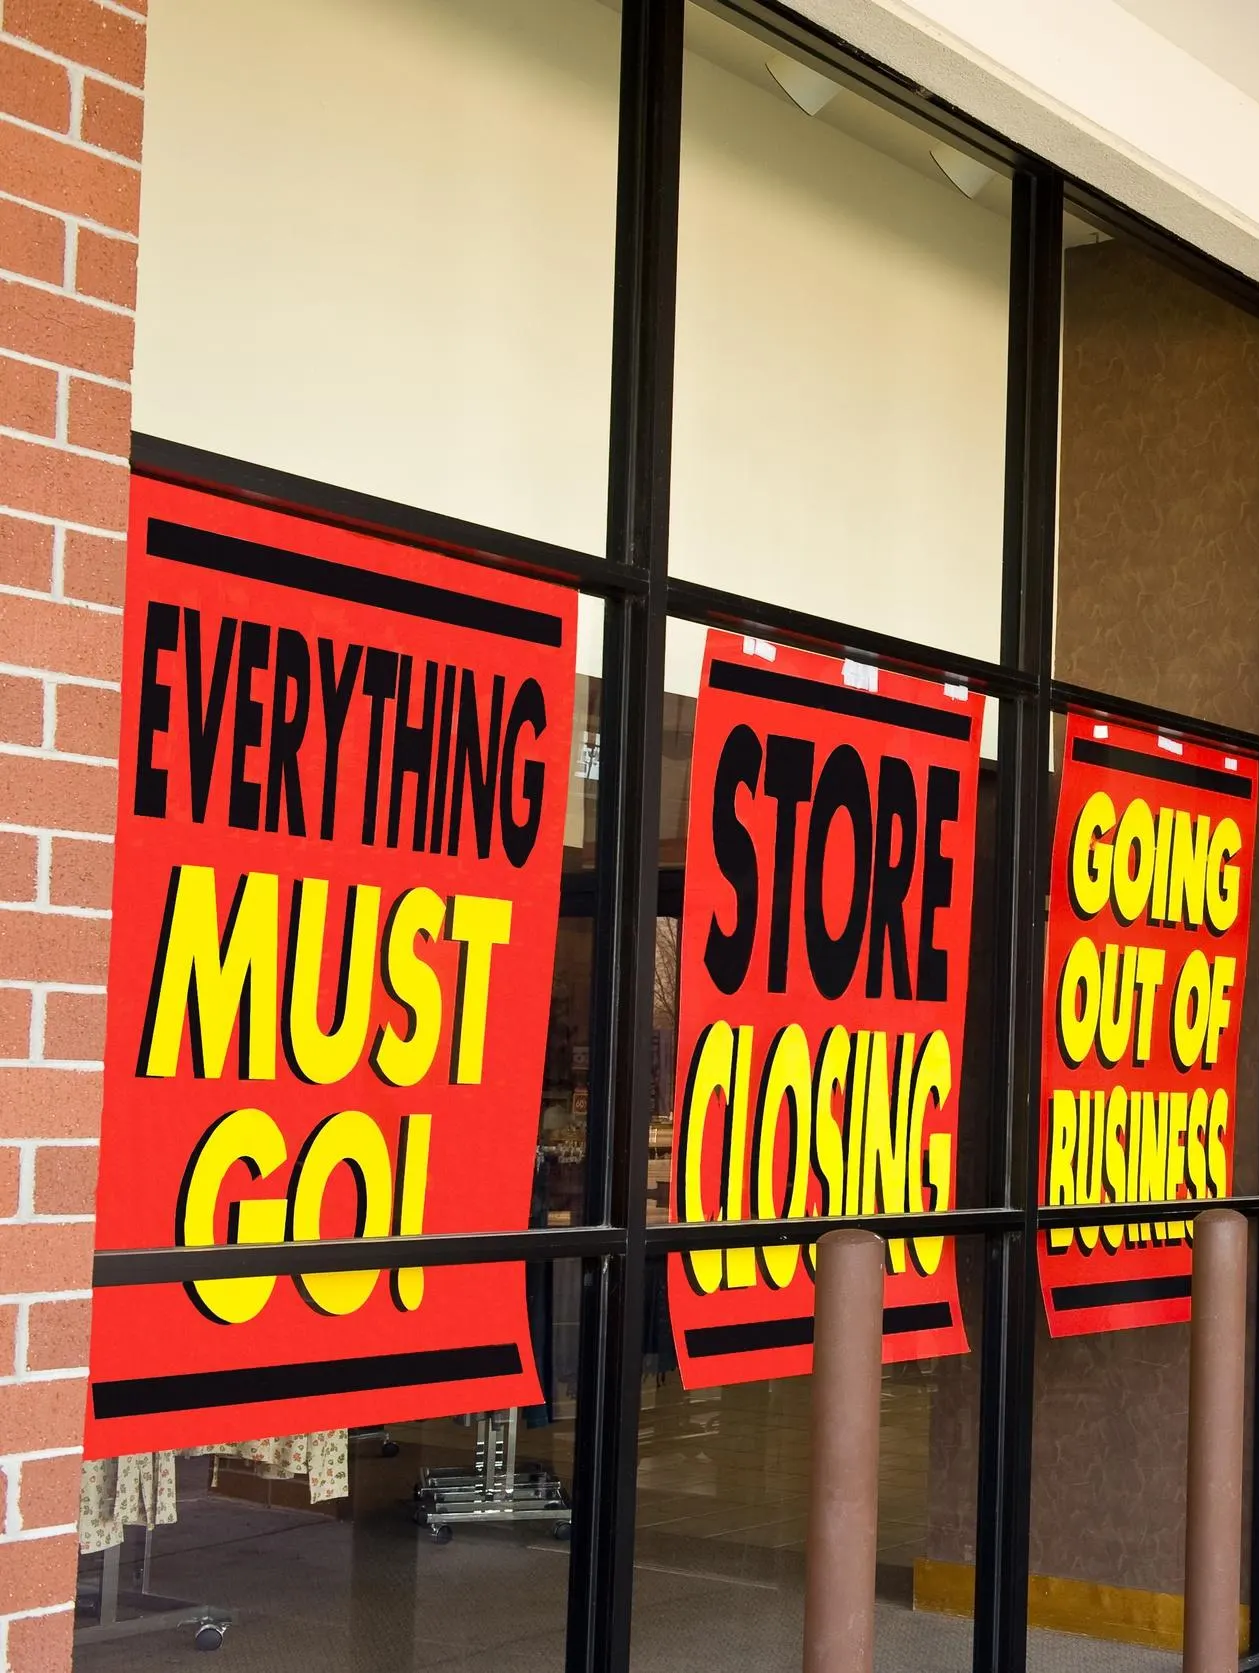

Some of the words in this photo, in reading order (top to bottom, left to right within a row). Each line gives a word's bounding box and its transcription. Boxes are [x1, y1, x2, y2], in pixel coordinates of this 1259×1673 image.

[133, 600, 547, 869] EVERYTHING
[703, 723, 961, 1002] STORE
[1068, 791, 1242, 937] GOING
[135, 864, 513, 1088] MUST
[1056, 937, 1166, 1070] OUT
[1169, 949, 1237, 1074] OF
[175, 1108, 433, 1326] GO!
[677, 1020, 952, 1297] CLOSING
[1045, 1085, 1229, 1257] BUSINESS
